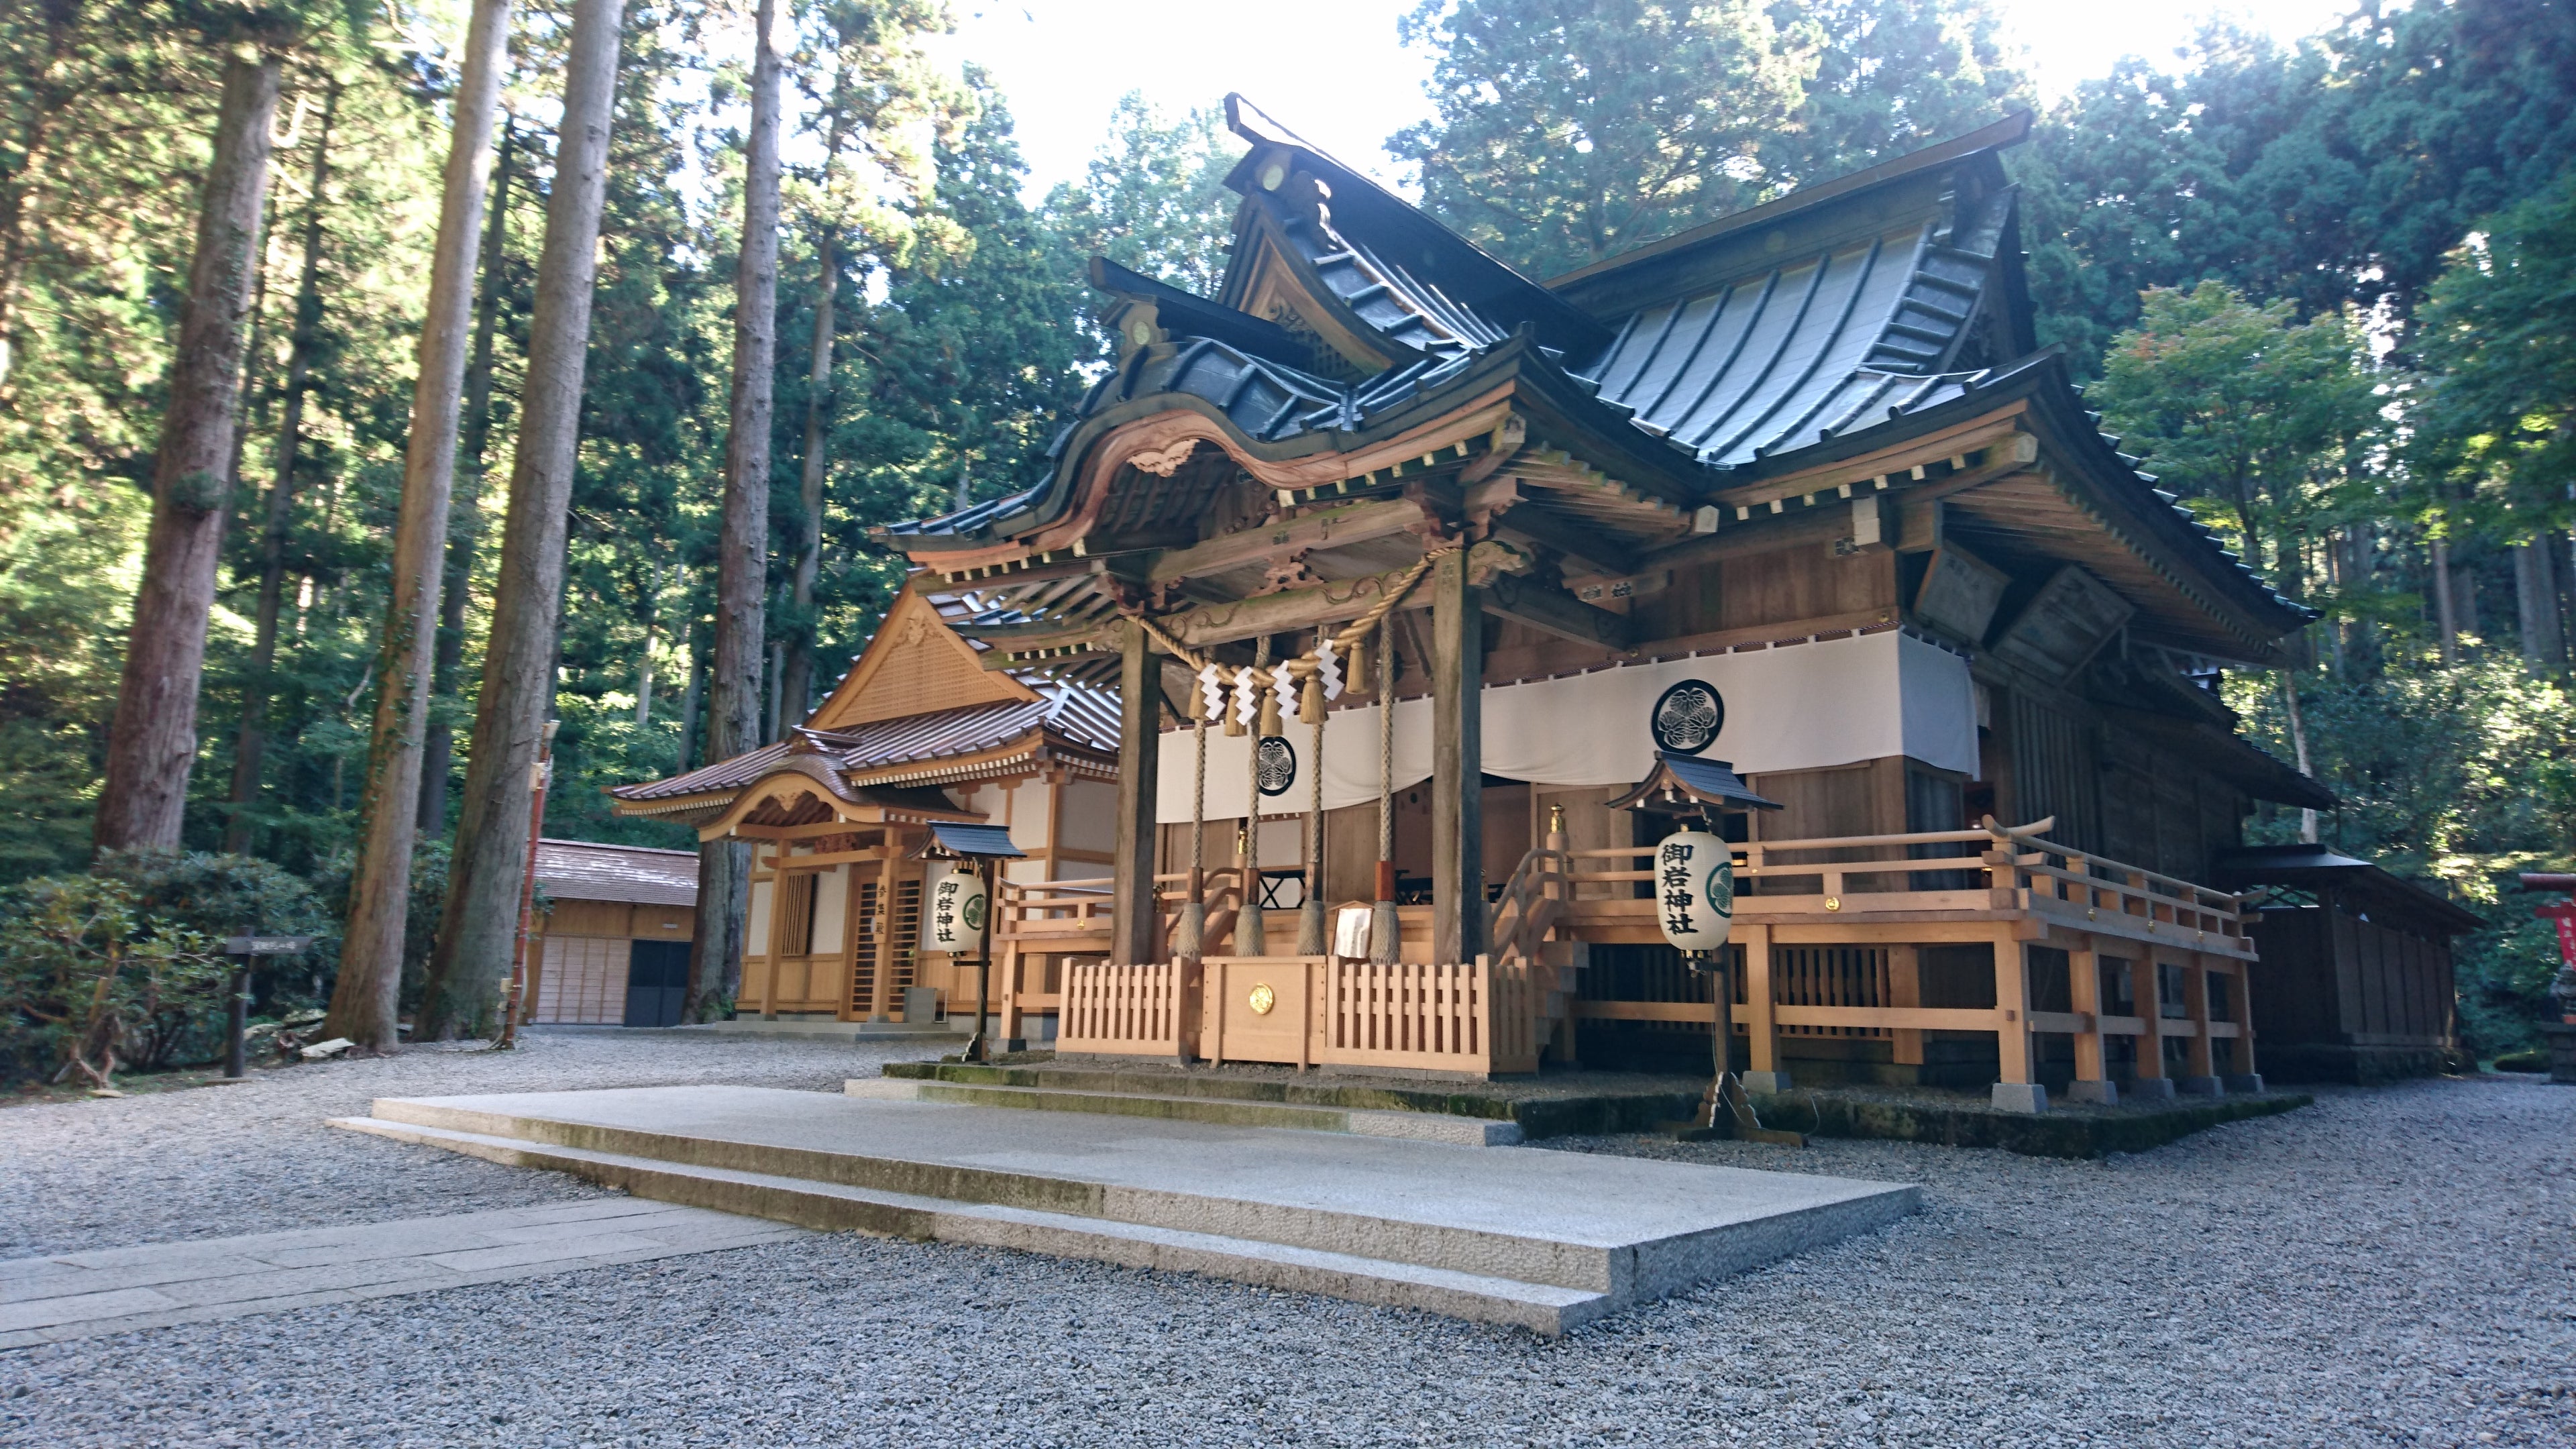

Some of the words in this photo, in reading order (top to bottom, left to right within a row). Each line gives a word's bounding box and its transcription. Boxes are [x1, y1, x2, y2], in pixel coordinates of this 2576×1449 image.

[936, 881, 959, 943] 御岩神社
[1661, 843, 1699, 934] 御岩神社
